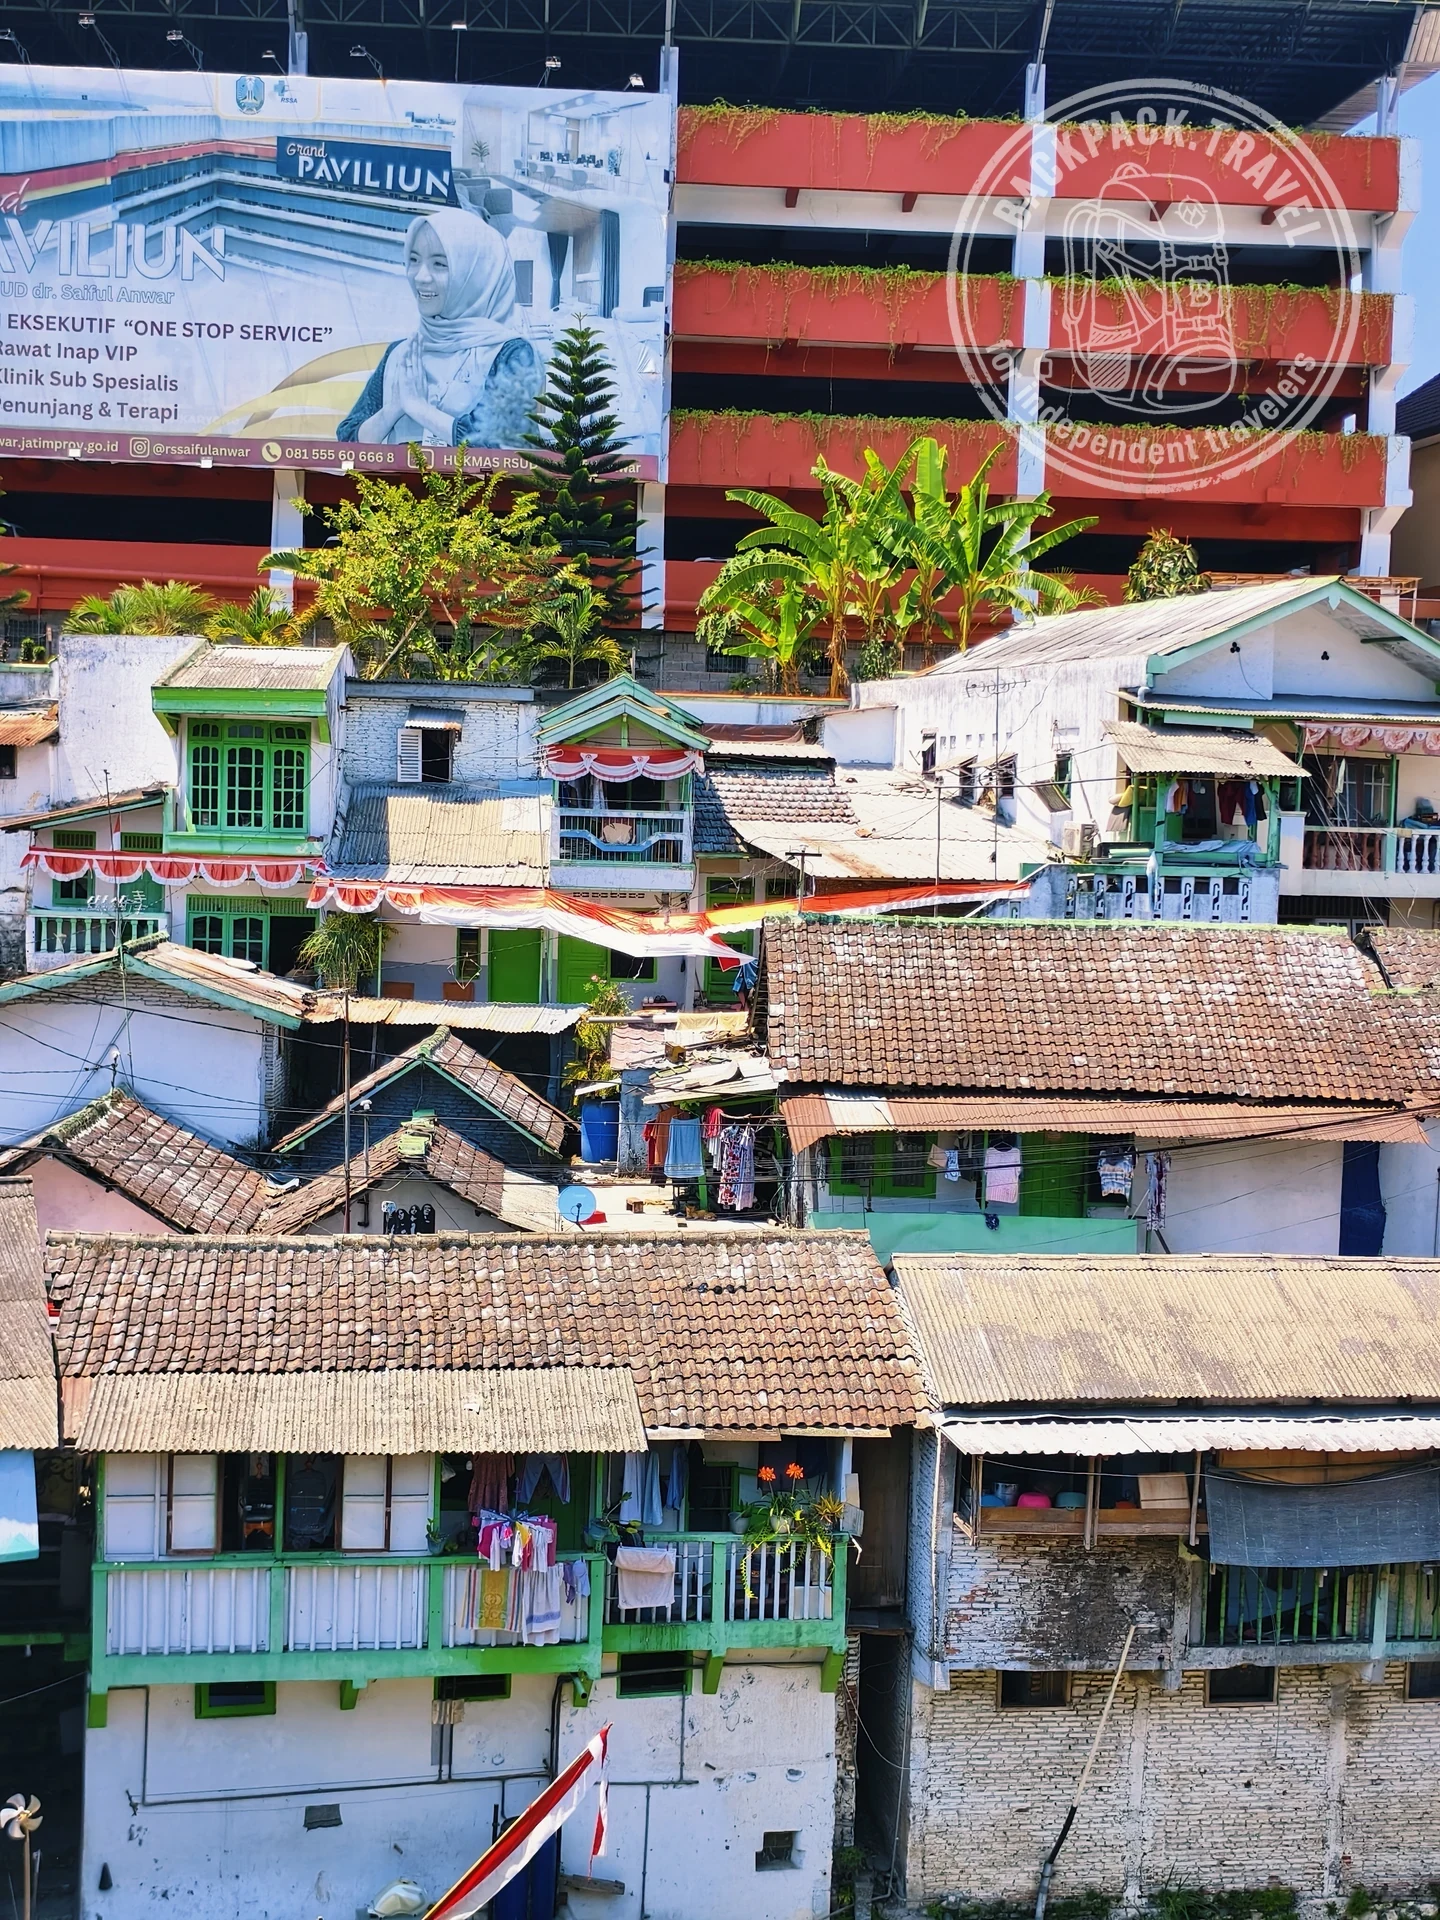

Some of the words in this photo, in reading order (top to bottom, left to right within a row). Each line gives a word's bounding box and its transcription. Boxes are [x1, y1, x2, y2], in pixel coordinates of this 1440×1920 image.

[286, 142, 327, 158] Grand
[298, 156, 450, 197] PAVILIUN
[32, 282, 57, 299] dr.
[61, 284, 114, 302] Saiful
[116, 286, 175, 305] Anwar
[7, 313, 116, 334] EKSEKUTIF
[124, 319, 177, 337] “ONE
[182, 322, 235, 340] STOP
[239, 324, 333, 343] SERVICE”
[57, 342, 99, 365] Inap
[105, 345, 138, 362] VIP
[50, 371, 87, 388] Sub
[92, 373, 179, 393] Spesialis
[0, 398, 94, 420] enunjang
[98, 401, 112, 418] &
[117, 402, 178, 424] Terapi
[153, 443, 251, 457] @rssaifulanwar
[285, 448, 309, 460] 081
[312, 449, 335, 460] 555
[338, 450, 355, 460] 60
[359, 451, 383, 462] 666
[386, 452, 394, 463] 8
